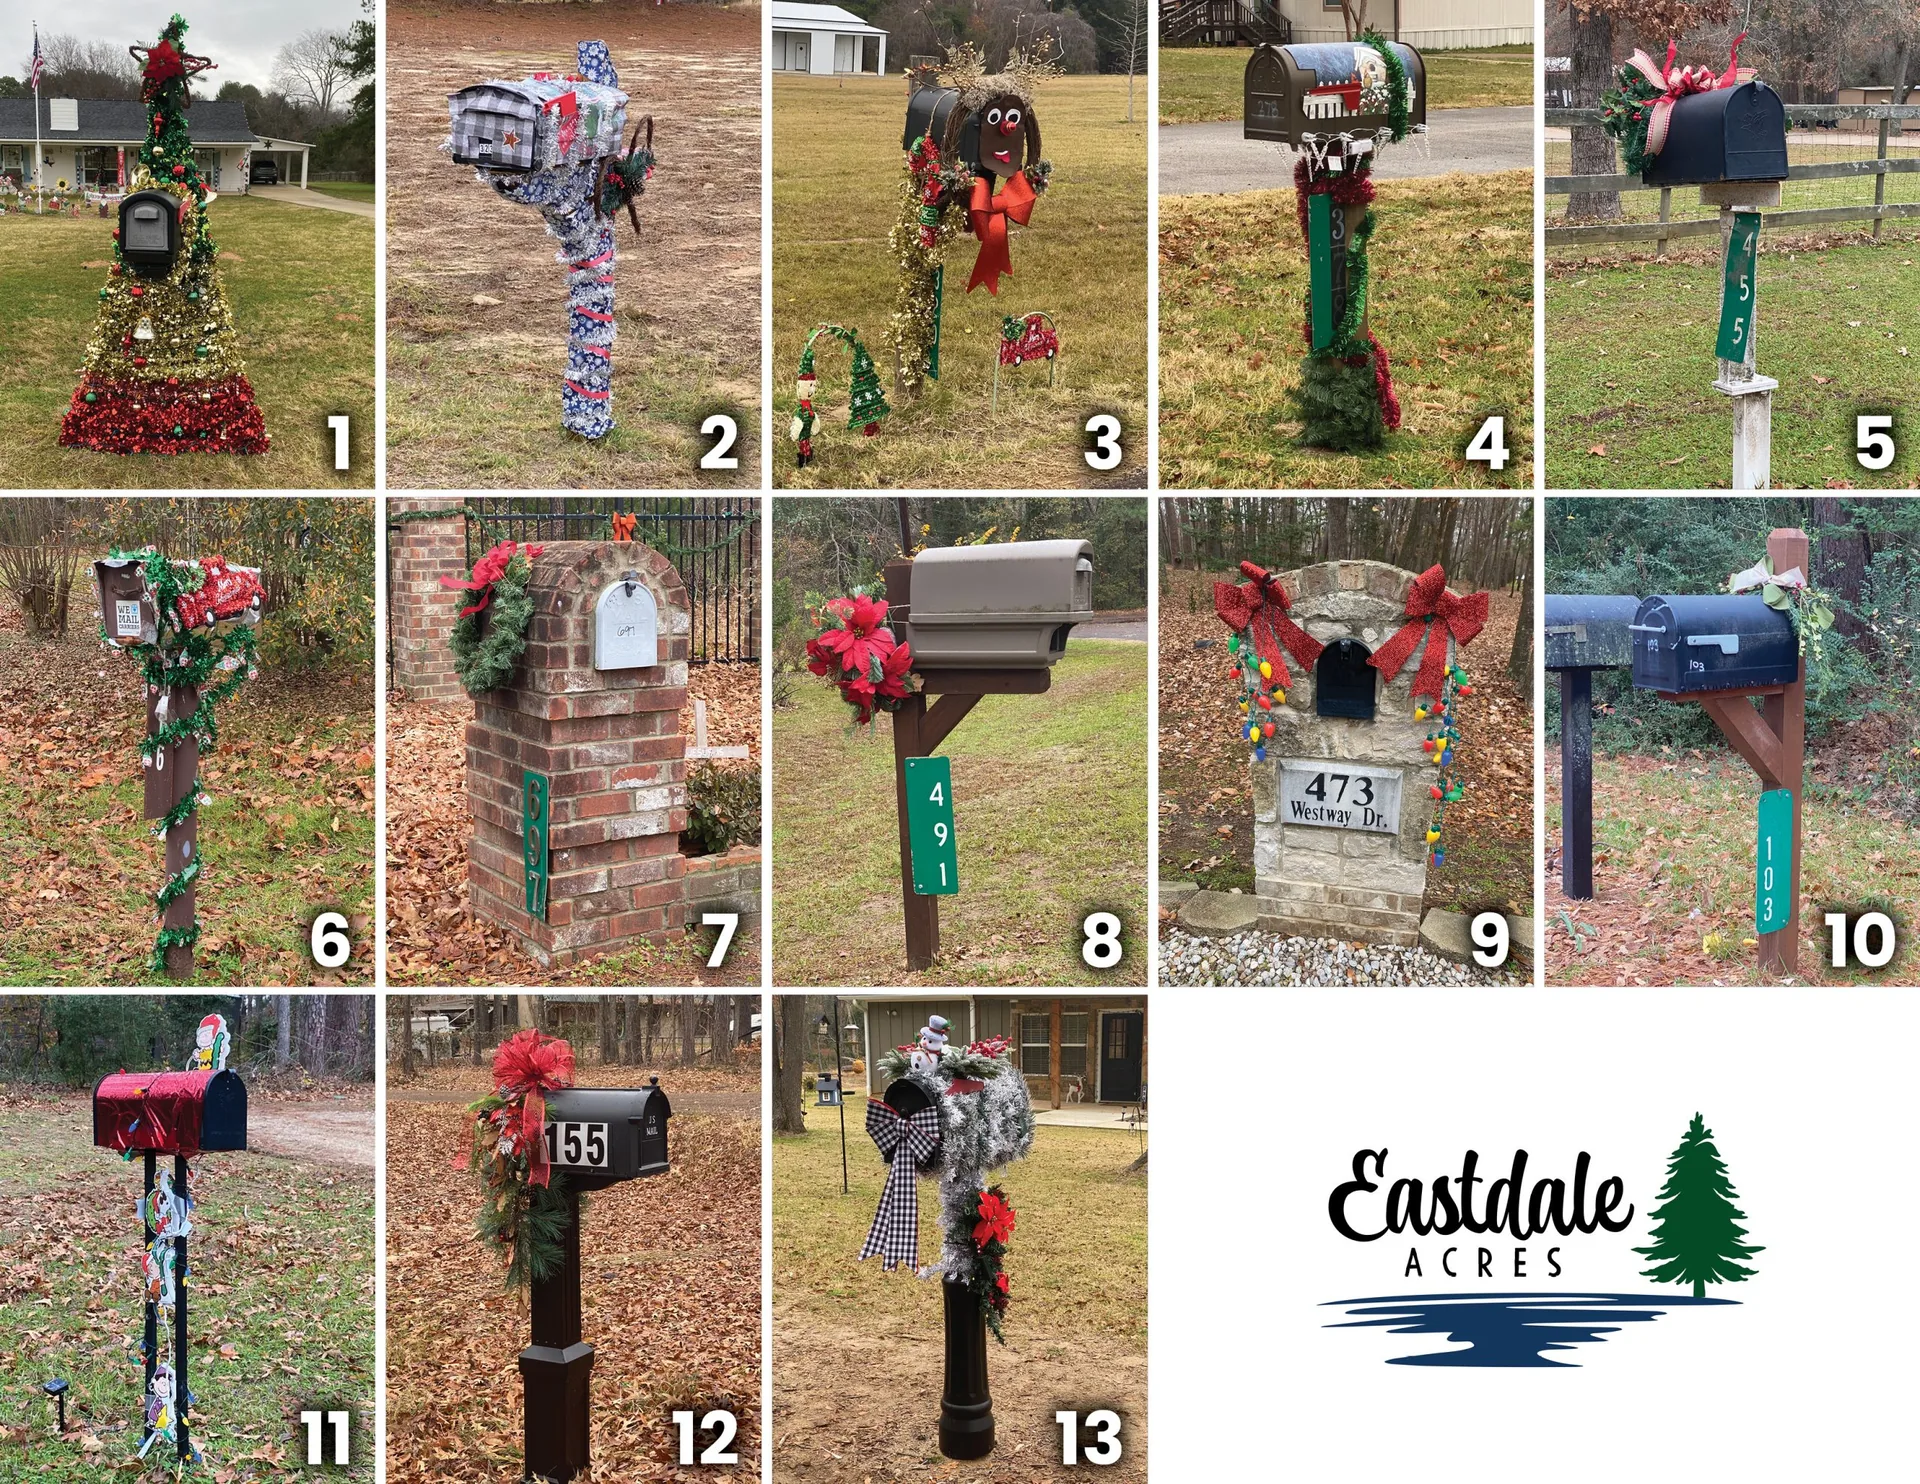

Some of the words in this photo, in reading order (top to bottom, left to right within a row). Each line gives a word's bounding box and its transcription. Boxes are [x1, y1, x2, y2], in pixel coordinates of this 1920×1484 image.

[1733, 231, 1754, 345] 455
[117, 605, 130, 614] WE
[118, 615, 140, 624] MAIL
[617, 625, 635, 637] 697
[1689, 659, 1704, 672] 103
[1305, 773, 1374, 806] 473
[1291, 800, 1352, 827] Westway
[1363, 807, 1388, 828] Dr.
[528, 779, 541, 912] 697
[929, 782, 948, 887] 491
[1763, 836, 1774, 921] 103
[545, 1122, 605, 1165] 155
